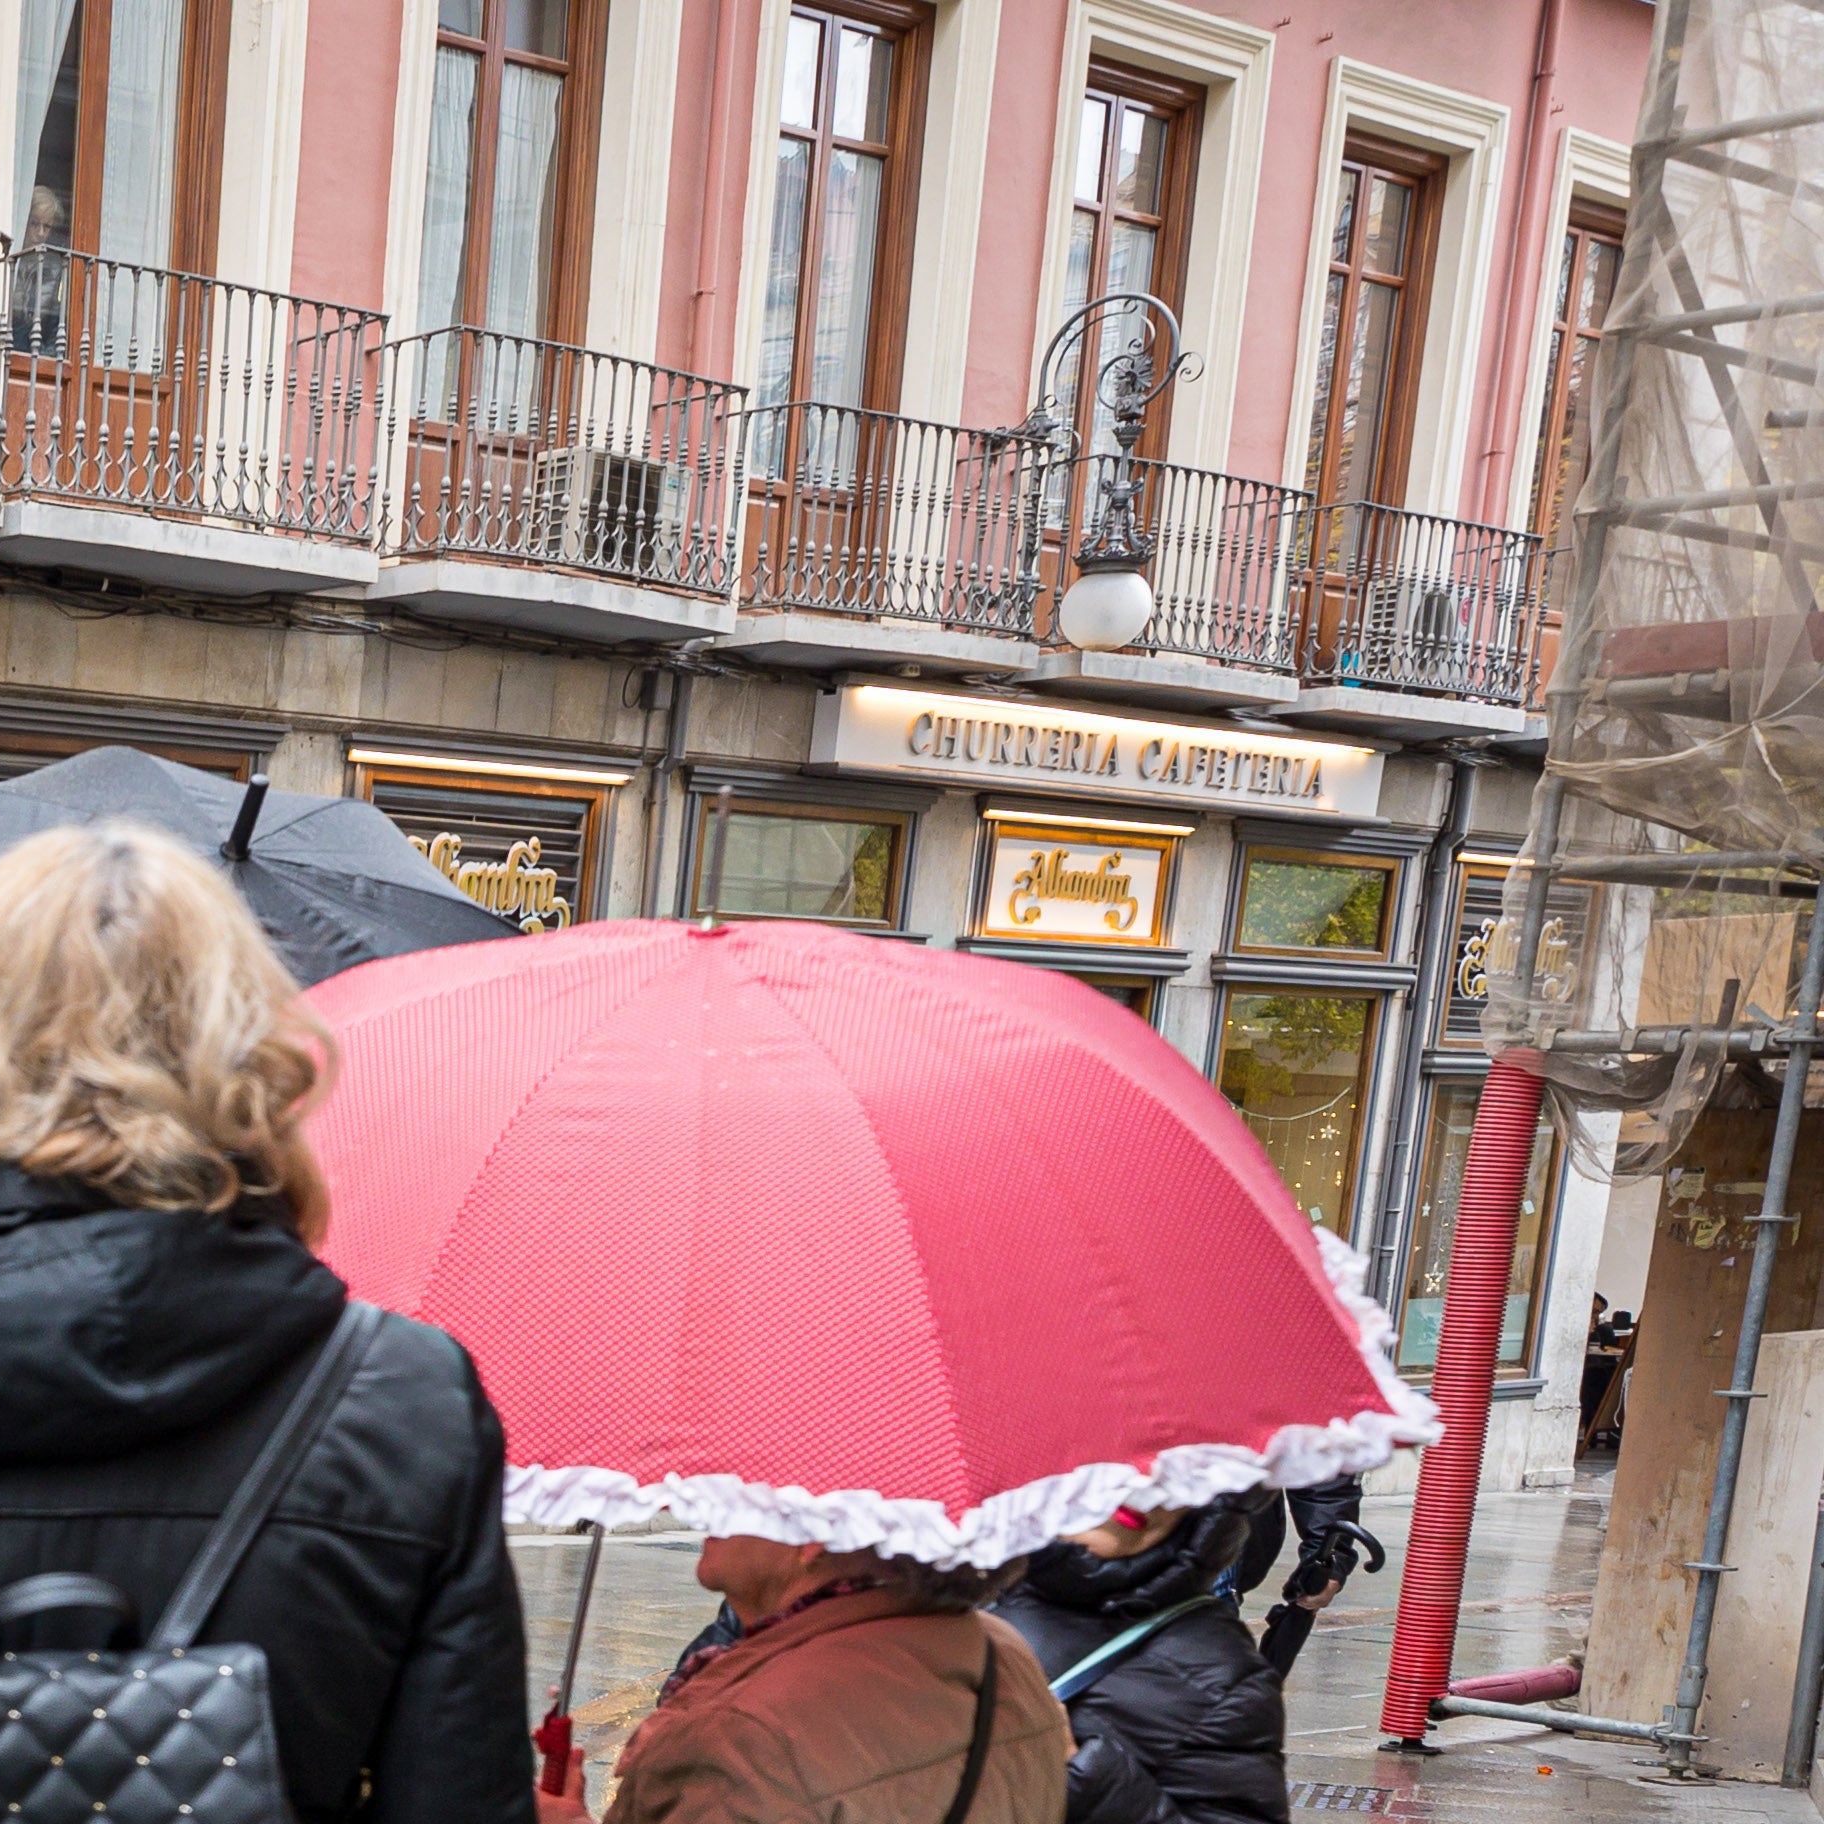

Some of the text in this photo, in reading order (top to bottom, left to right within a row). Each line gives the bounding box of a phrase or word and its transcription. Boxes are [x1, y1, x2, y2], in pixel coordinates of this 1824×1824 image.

[909, 711, 1324, 799] CHURRERIA CAFETERIA
[1012, 850, 1138, 920] Alhambra
